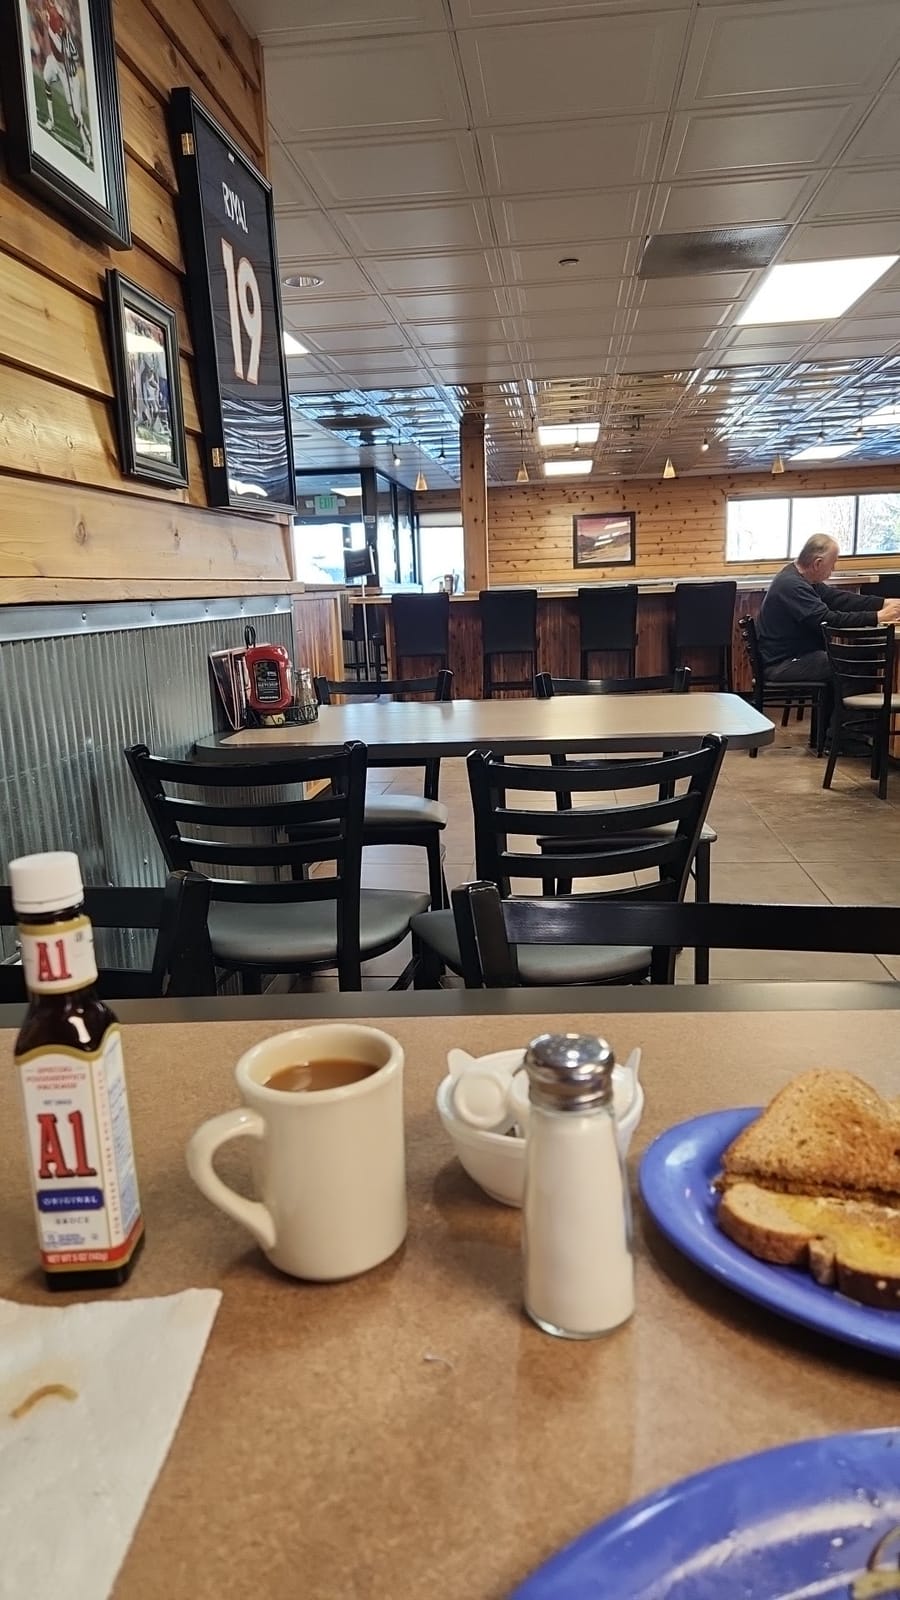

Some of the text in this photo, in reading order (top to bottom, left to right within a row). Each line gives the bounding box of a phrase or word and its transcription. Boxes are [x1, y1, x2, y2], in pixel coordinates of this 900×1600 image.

[221, 237, 262, 385] 19
[36, 939, 72, 982] A1
[37, 1110, 97, 1179] A1
[43, 1195, 98, 1206] ORIGINAL
